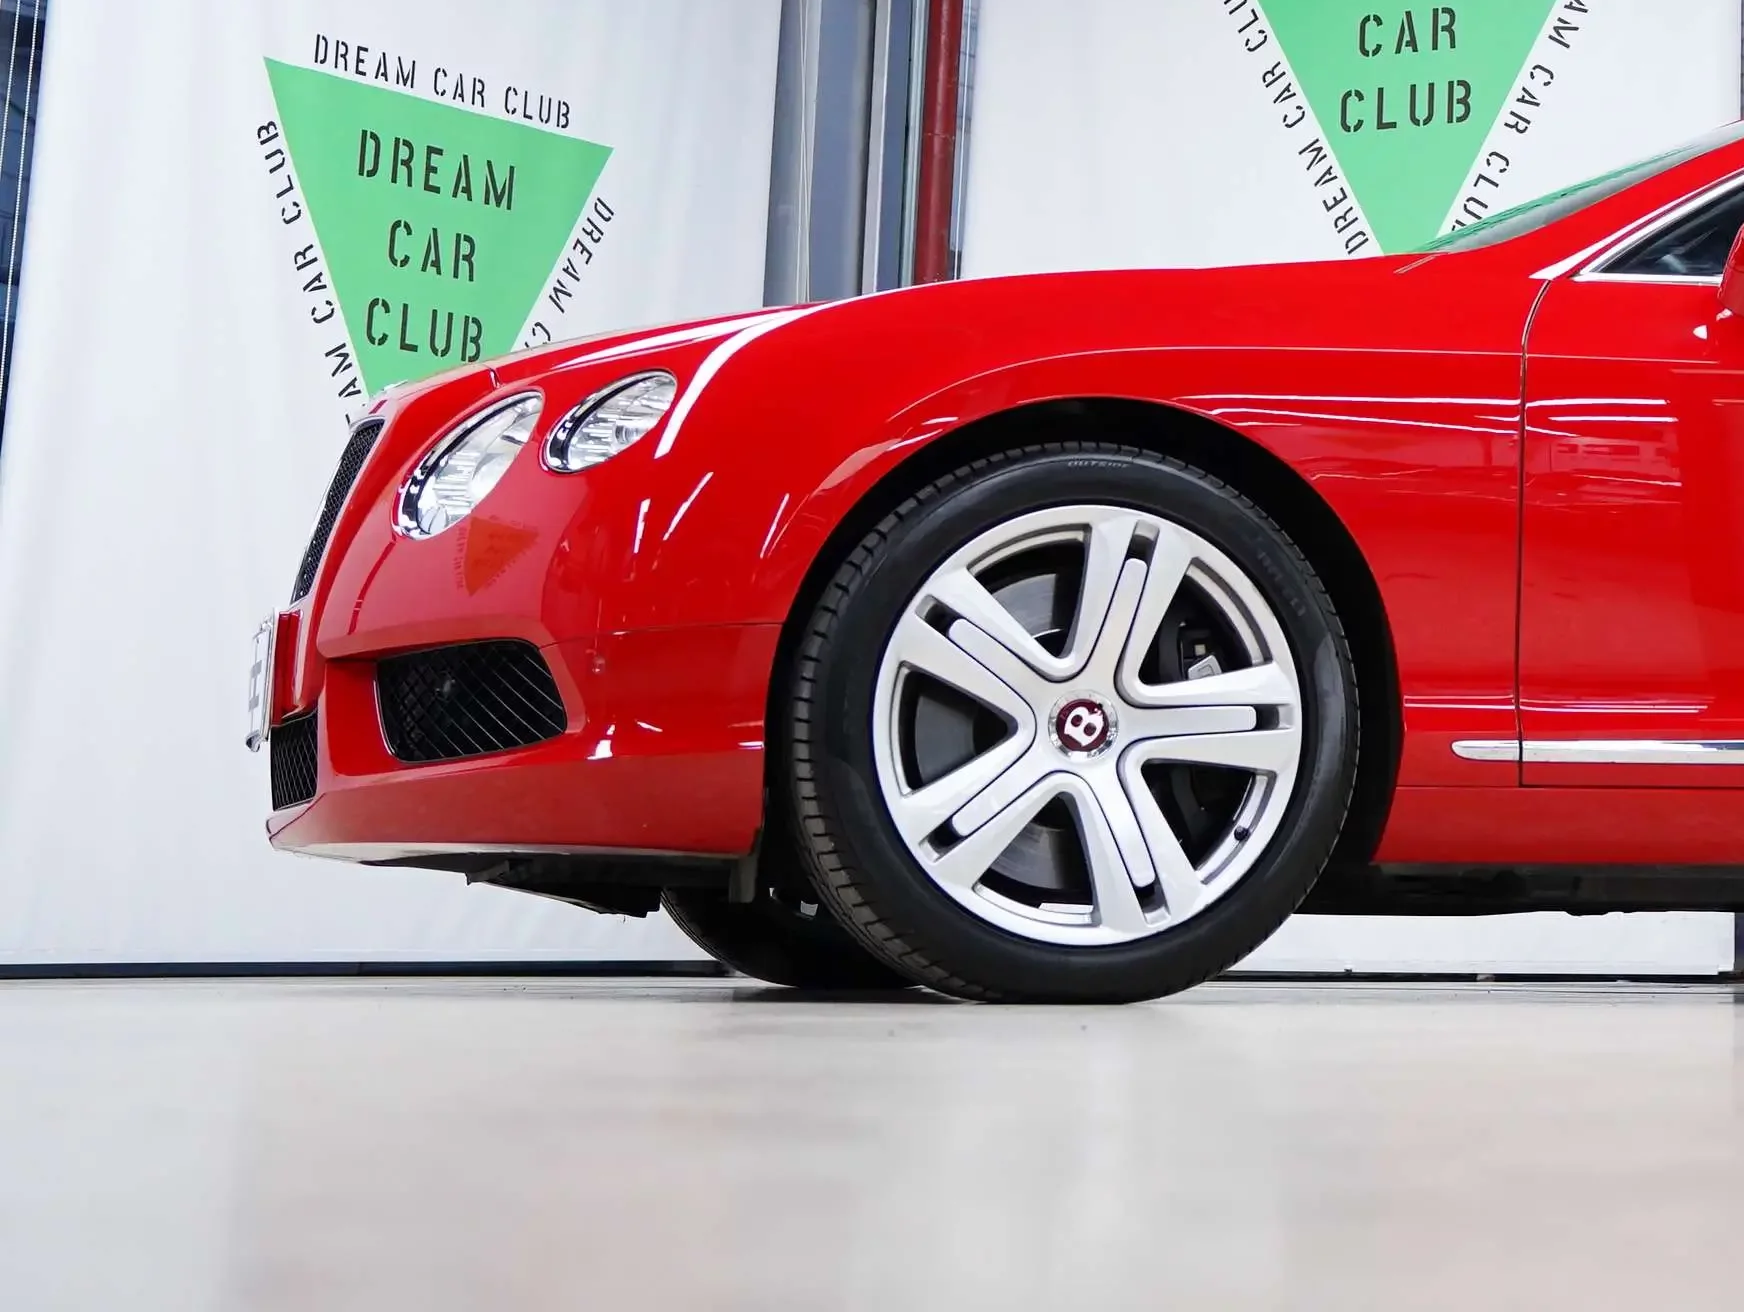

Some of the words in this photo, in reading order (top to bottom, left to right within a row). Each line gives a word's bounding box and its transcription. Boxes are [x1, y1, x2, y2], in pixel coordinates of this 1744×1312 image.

[1358, 7, 1456, 57] CAR
[314, 34, 416, 88] DREAM
[433, 67, 486, 108] CAR
[504, 86, 570, 128] CLUB
[1262, 61, 1305, 129] CAR
[1340, 79, 1472, 133] CLUB
[1504, 64, 1554, 135] CAR
[257, 120, 301, 225] CLUB
[357, 129, 516, 210] DREAM
[1298, 138, 1369, 255] DREAM
[1451, 150, 1510, 232] CLU
[294, 243, 335, 324] CAR
[388, 219, 476, 282] CAR
[548, 196, 615, 314] DREAM
[366, 297, 483, 363] CLUB
[1065, 706, 1104, 746] B
